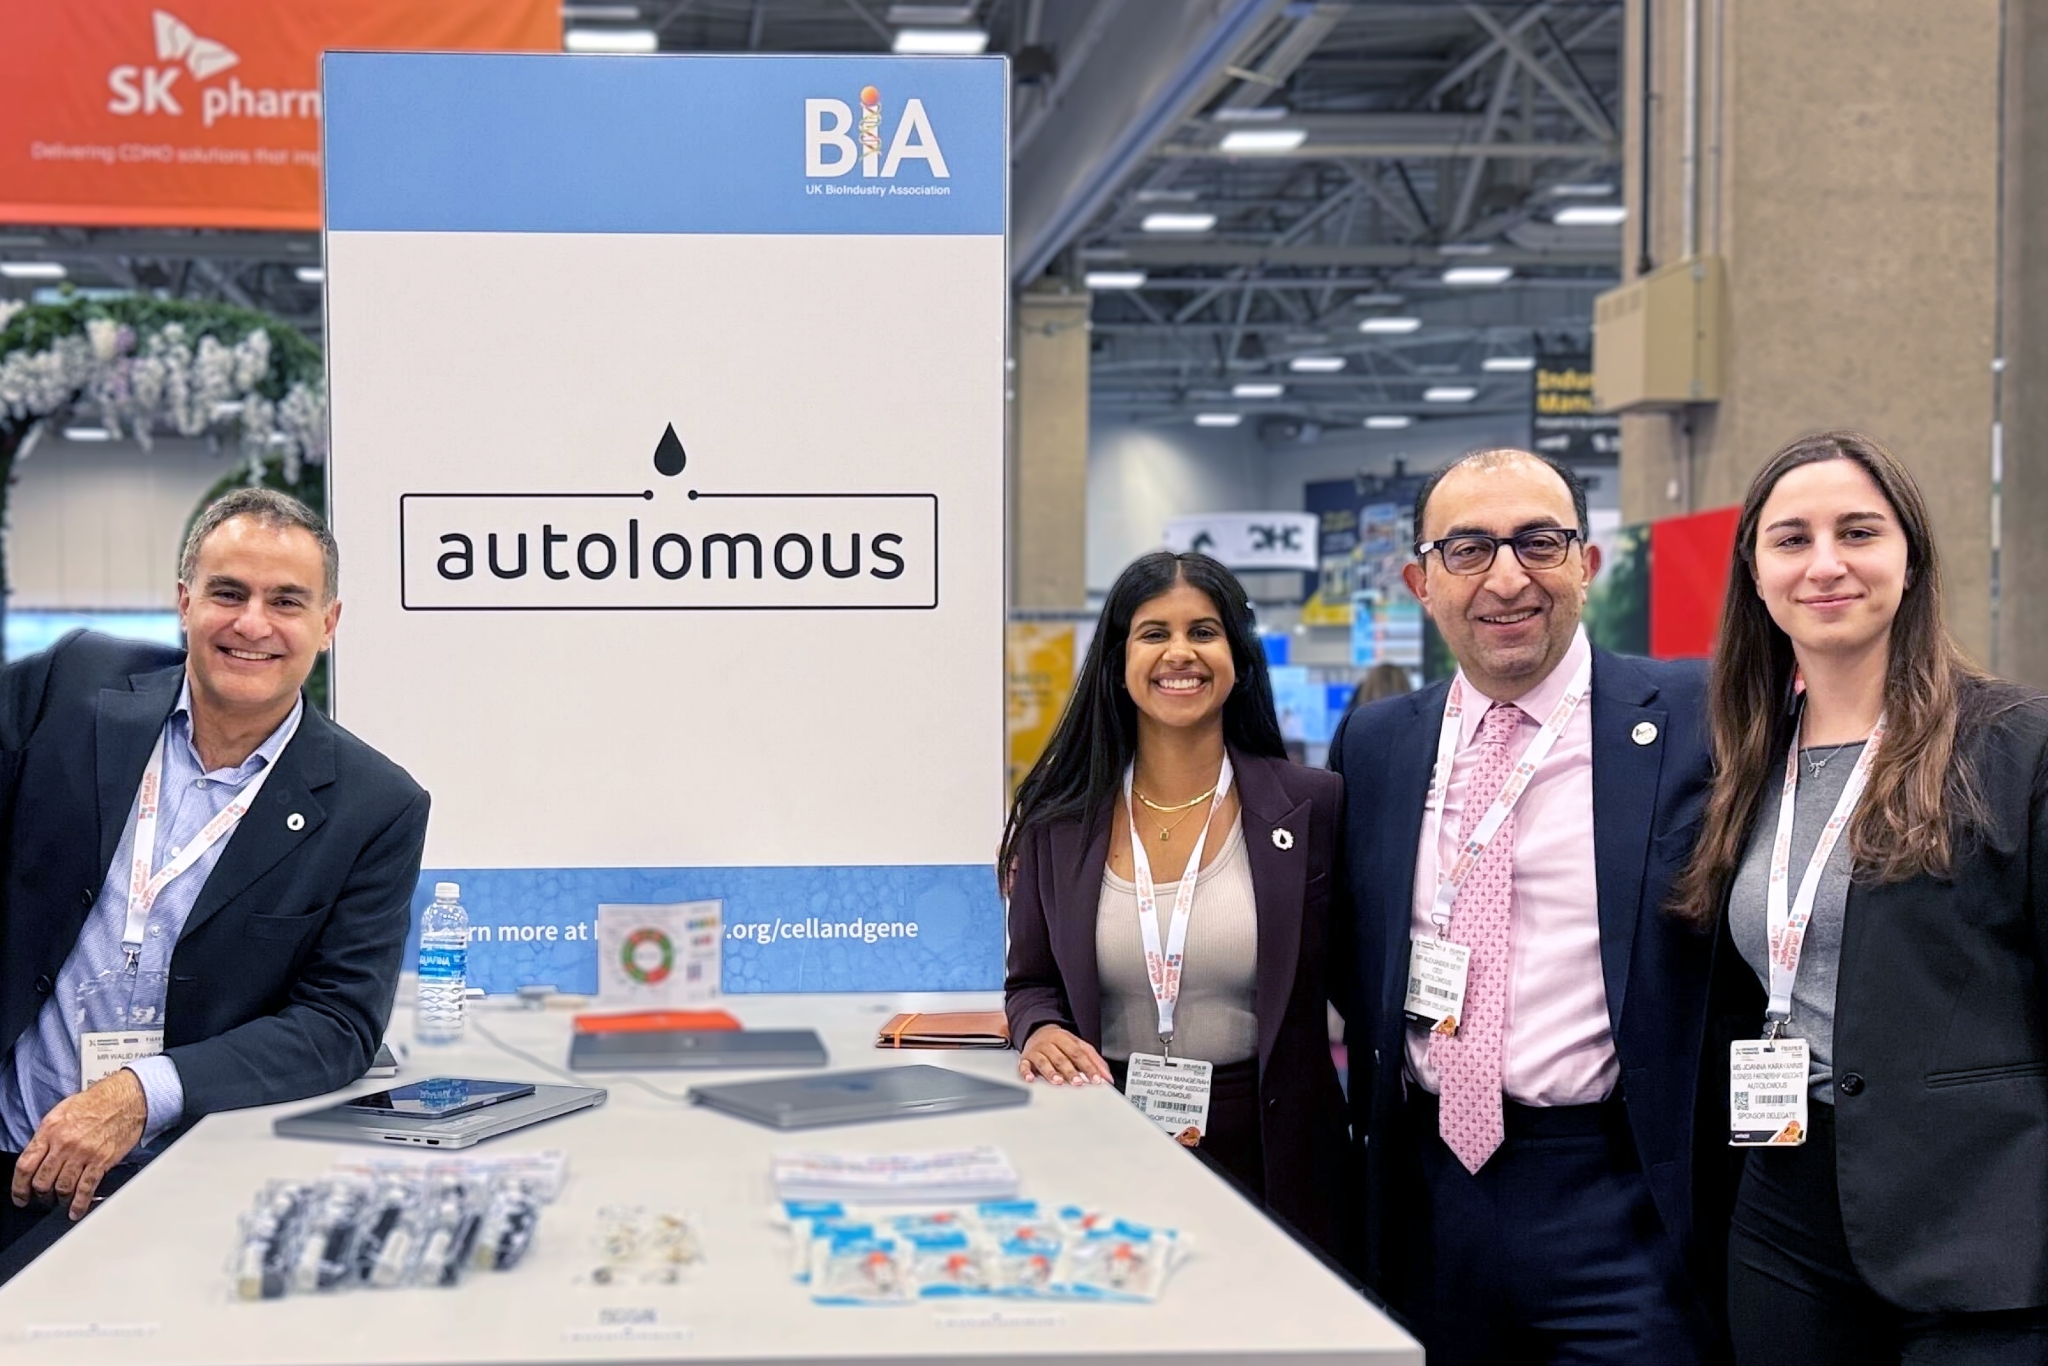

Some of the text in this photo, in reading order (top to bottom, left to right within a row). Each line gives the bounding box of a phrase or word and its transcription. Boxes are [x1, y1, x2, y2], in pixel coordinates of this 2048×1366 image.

[107, 66, 184, 115] SK
[30, 141, 115, 165] Delivering
[806, 185, 950, 197] UK BioIndustry Association
[437, 519, 906, 581] autolomous
[498, 925, 558, 942] more
[564, 922, 588, 941] at
[1791, 931, 1800, 945] Gift
[1781, 929, 1793, 964] Biologics
[1786, 956, 1796, 971] Life
[1747, 1082, 1788, 1090] AUTOLOMOUS
[1146, 1089, 1192, 1100] AUTOLOMOUS
[1165, 1115, 1199, 1126] DELEGATE
